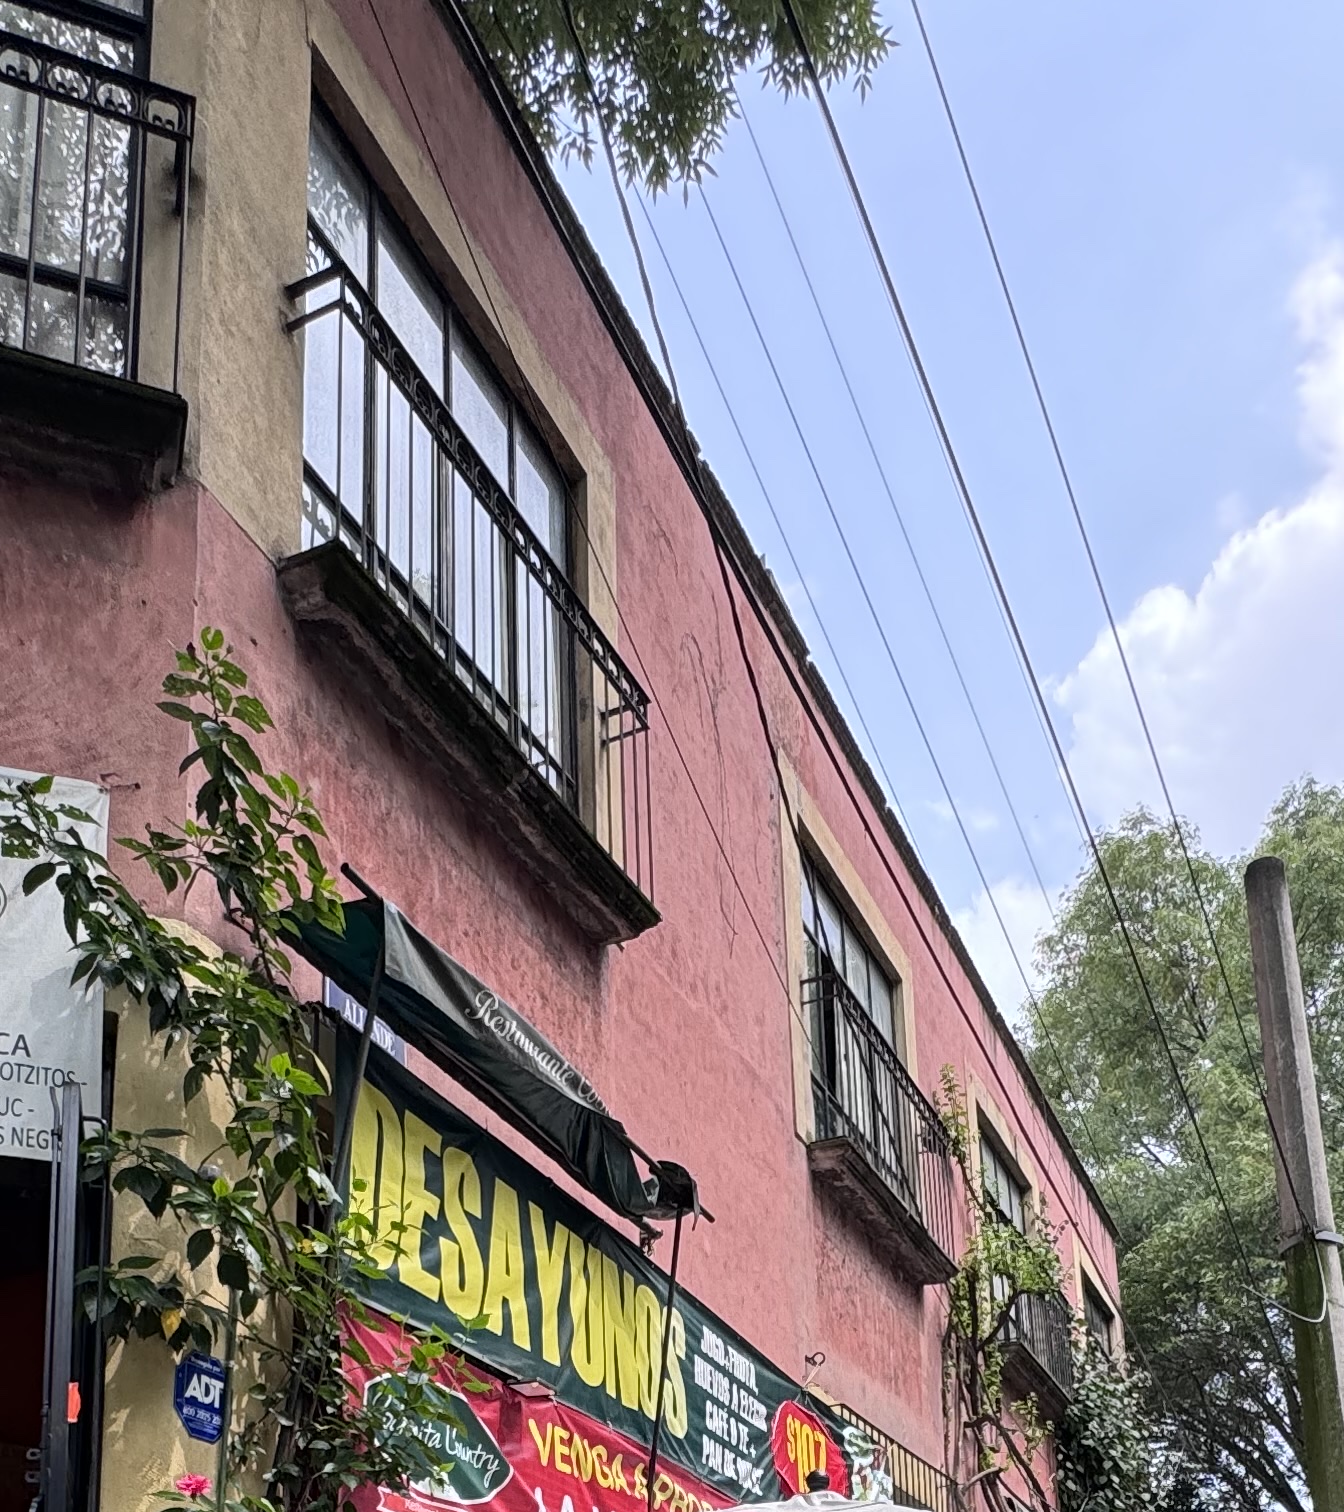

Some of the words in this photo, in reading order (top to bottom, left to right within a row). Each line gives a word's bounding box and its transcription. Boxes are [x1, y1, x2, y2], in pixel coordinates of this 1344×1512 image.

[464, 989, 576, 1085] Restaurante
[10, 1126, 58, 1151] NEG
[344, 1077, 689, 1440] DESAYUNOS
[184, 1373, 224, 1409] ADT
[694, 1353, 731, 1407] HUEVOS
[731, 1383, 739, 1413] A
[705, 1399, 730, 1442] CAFÉ
[730, 1417, 738, 1446] O
[445, 1423, 501, 1489] Country
[528, 1418, 632, 1496] VENGA
[701, 1433, 723, 1475] PAN
[723, 1447, 738, 1481] DE
